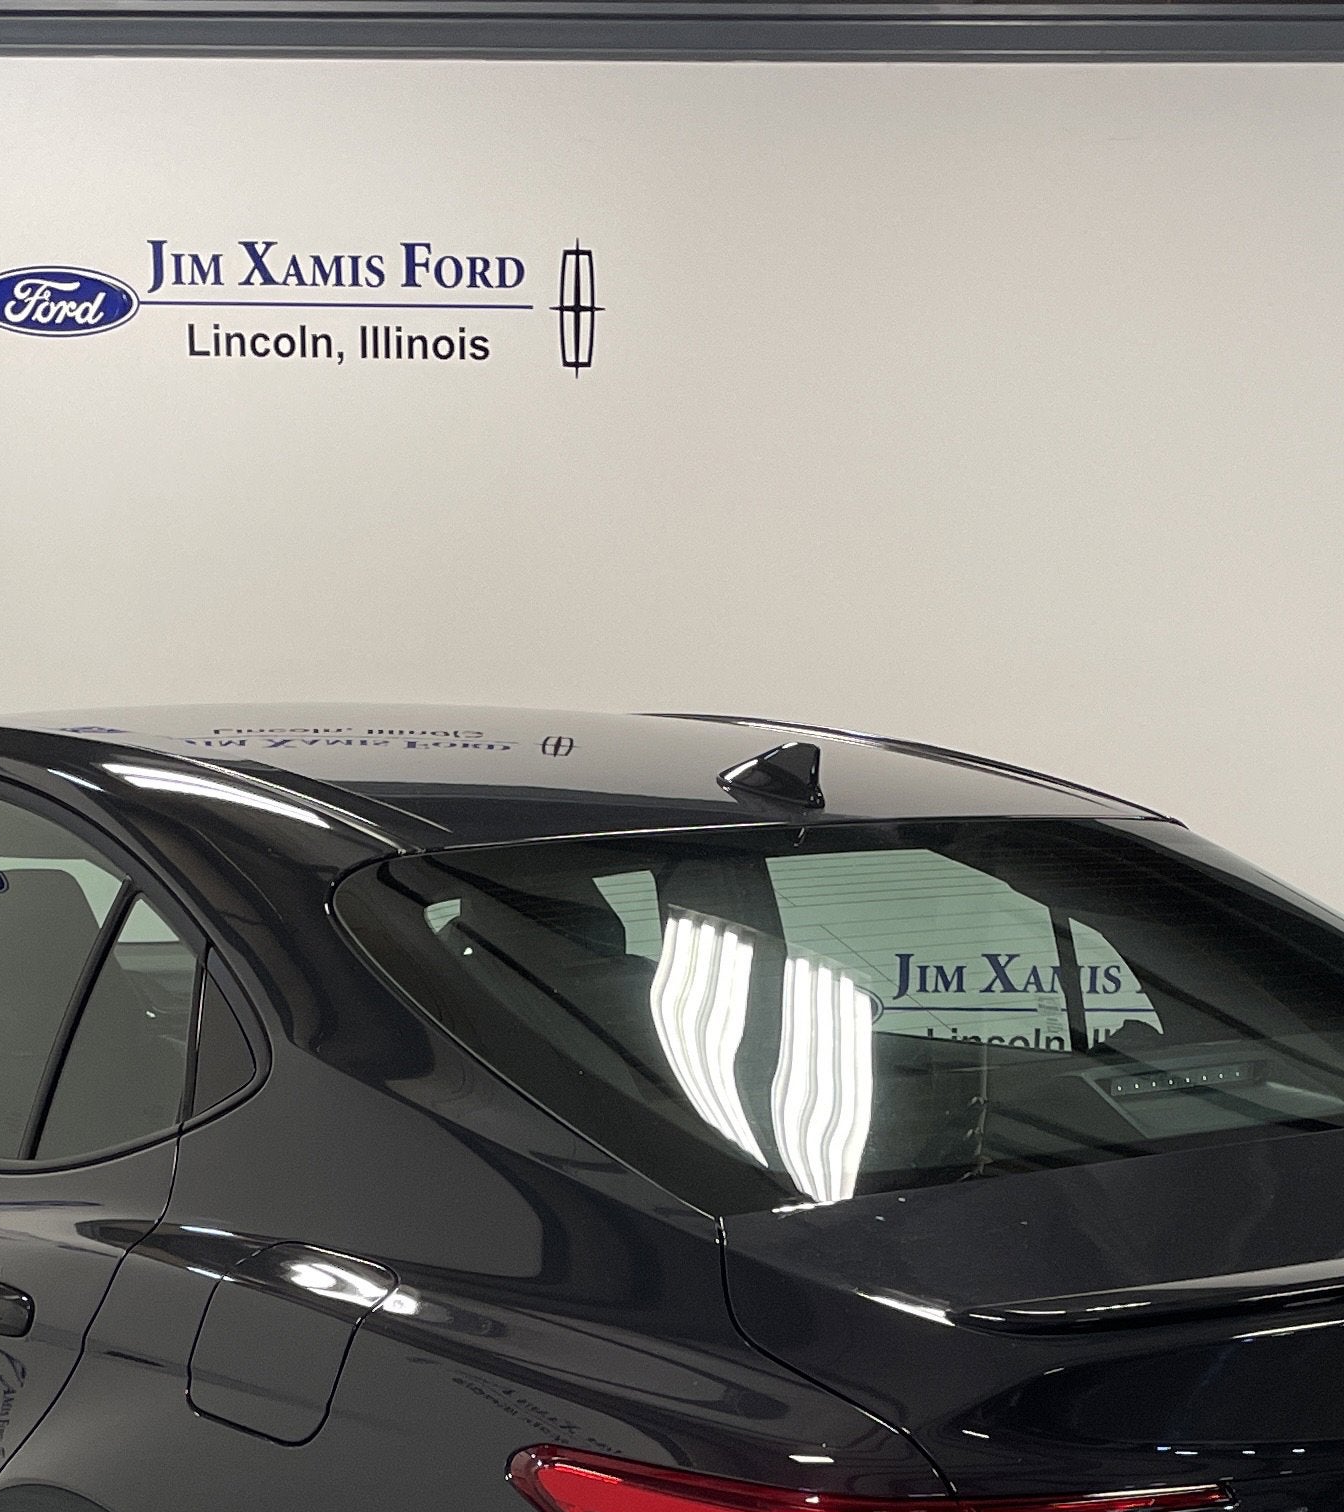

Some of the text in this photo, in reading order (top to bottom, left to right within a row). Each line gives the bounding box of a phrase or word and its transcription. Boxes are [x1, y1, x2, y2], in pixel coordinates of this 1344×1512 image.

[146, 239, 525, 293] JIM XAMIS FORD
[4, 278, 105, 326] Ford
[187, 323, 490, 365] Lincoln, Illinois
